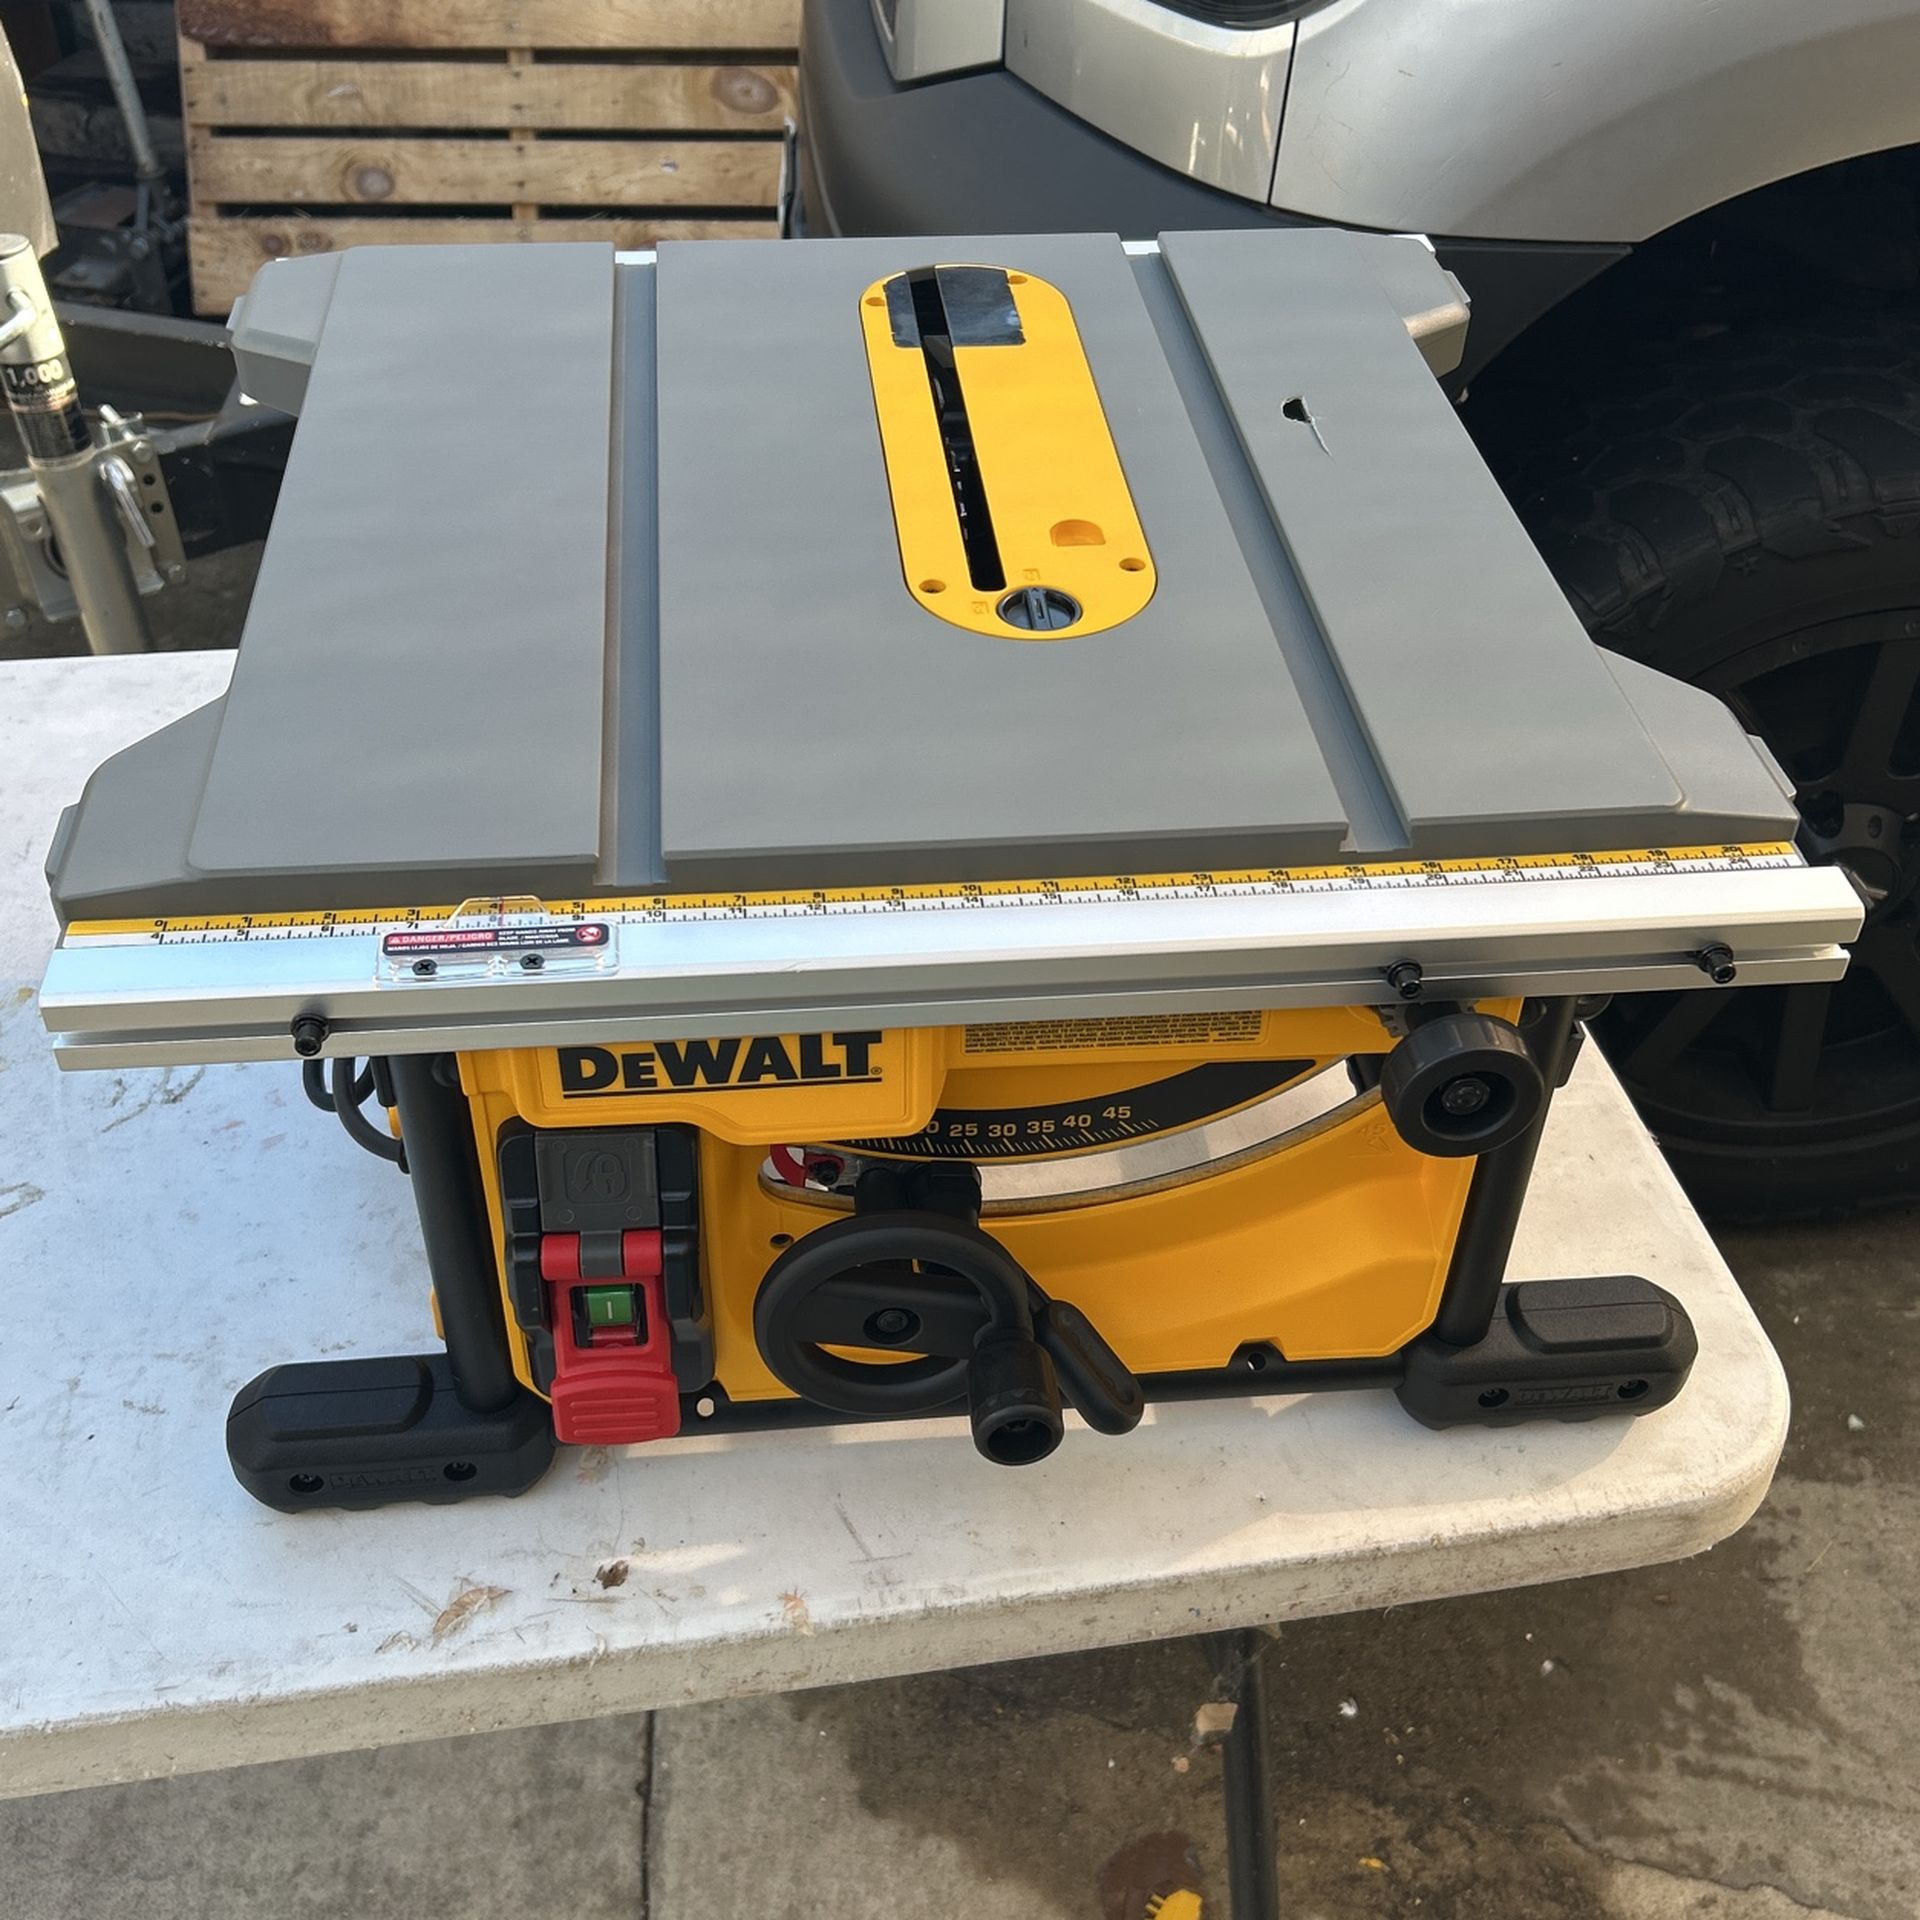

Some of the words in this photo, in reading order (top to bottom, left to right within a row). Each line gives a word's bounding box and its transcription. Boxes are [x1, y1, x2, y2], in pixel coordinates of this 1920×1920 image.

[6, 359, 63, 388] 1,000
[402, 931, 493, 944] DANGER/PELIGRO
[557, 1031, 882, 1091] DEWALT
[950, 1123, 978, 1137] 25
[988, 1123, 1017, 1137] 30
[1027, 1120, 1055, 1134] 35
[1063, 1114, 1092, 1128] 40
[1103, 1106, 1132, 1119] 45
